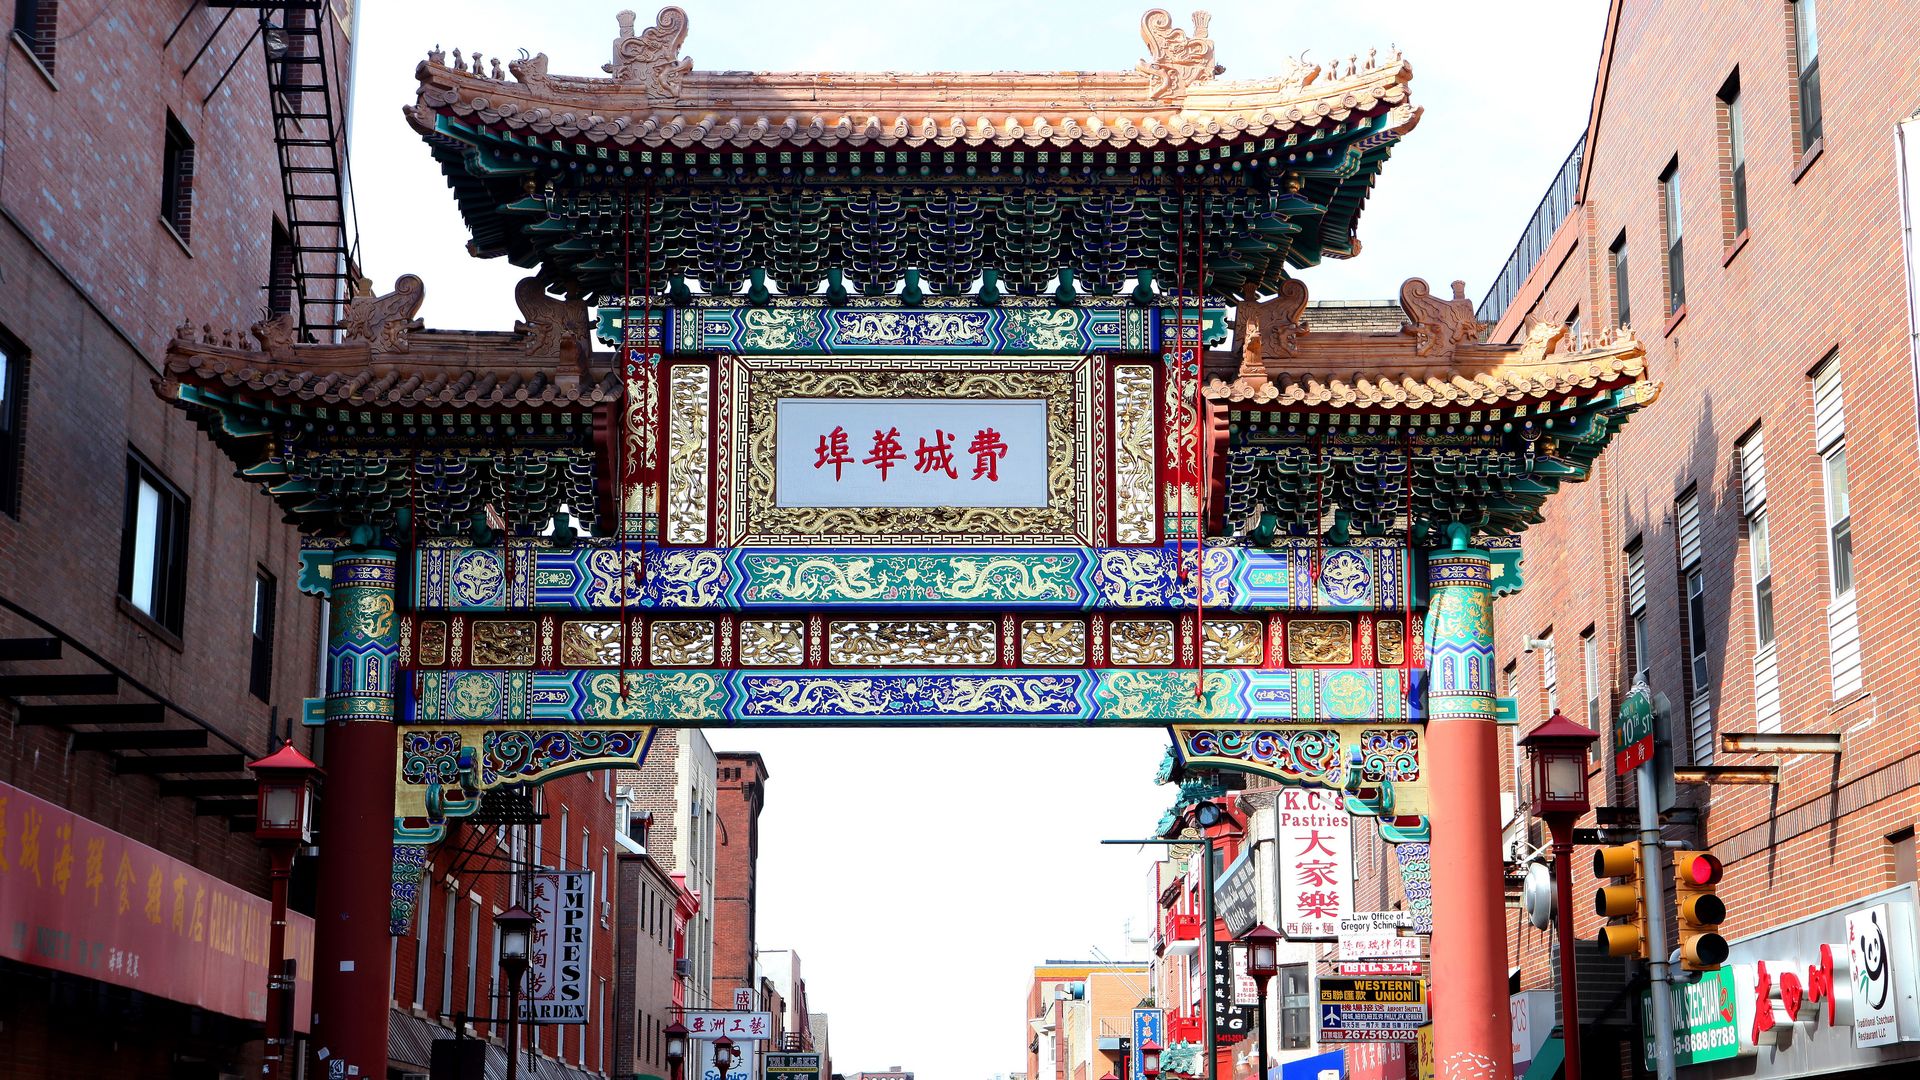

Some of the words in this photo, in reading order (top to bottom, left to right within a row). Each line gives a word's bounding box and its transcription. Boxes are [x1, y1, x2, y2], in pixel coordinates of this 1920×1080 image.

[1642, 713, 1650, 734] ST
[1624, 742, 1645, 769] 十街
[1284, 791, 1344, 811] K.C.'s
[1281, 813, 1349, 827] Pastries
[1294, 829, 1340, 919] 大家樂
[1352, 913, 1368, 921] Law
[1371, 912, 1394, 921] Office
[1396, 911, 1405, 920] of
[1340, 921, 1371, 932] Gregory
[561, 875, 585, 1001] EMPRESS
[1354, 980, 1412, 990] WESTERN
[1375, 990, 1411, 1001] UNION
[1684, 978, 1720, 1029] SZECHUAN
[518, 1004, 585, 1018] GARDEN
[1856, 1017, 1876, 1028] Traditional
[1875, 1014, 1895, 1025] Szechuan
[1858, 1029, 1878, 1041] Restaurant
[1878, 1027, 1887, 1038] LLC
[789, 1057, 817, 1067] LAKE
